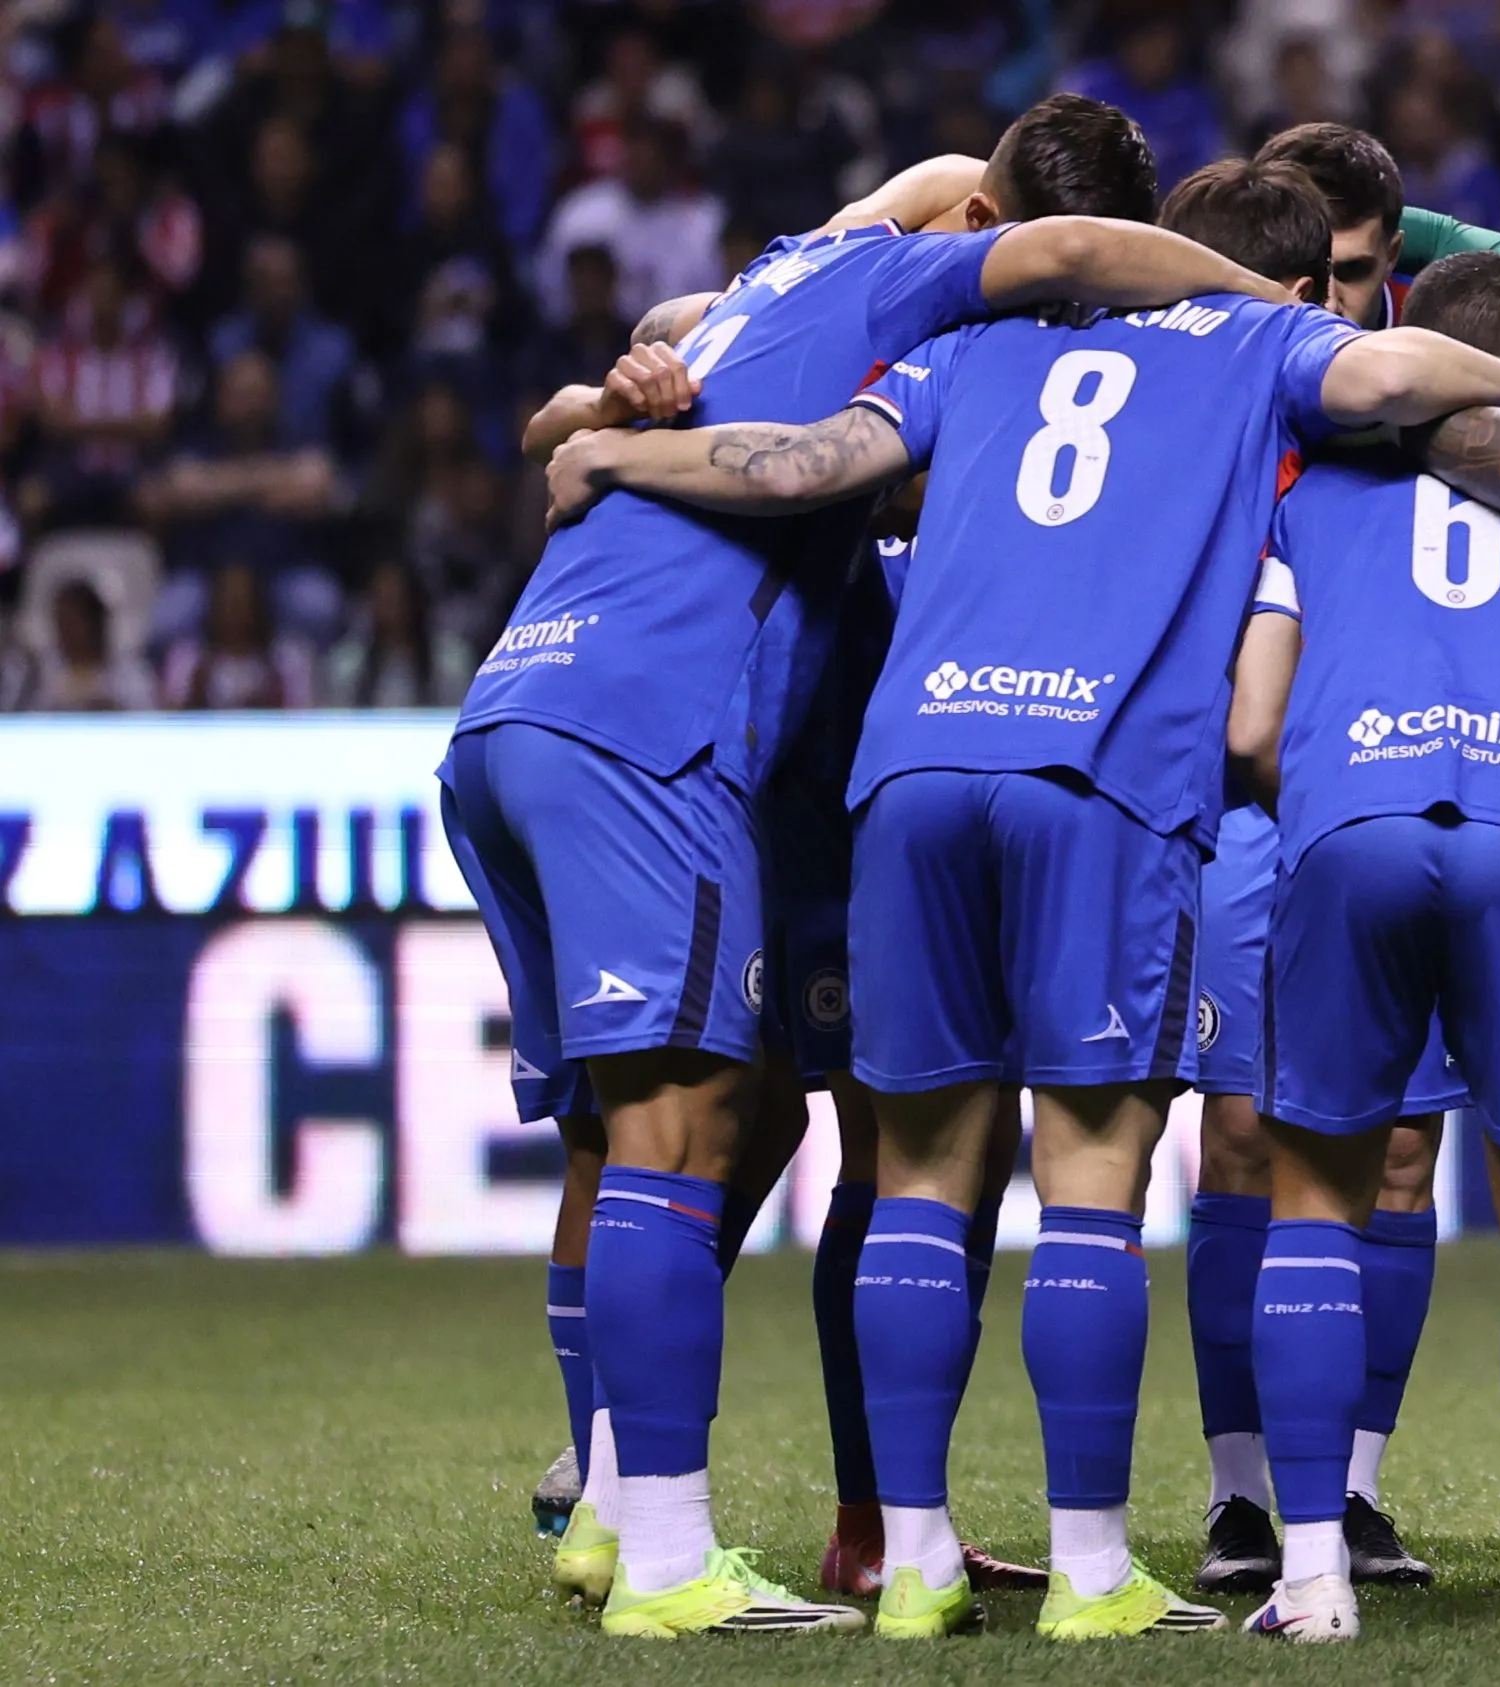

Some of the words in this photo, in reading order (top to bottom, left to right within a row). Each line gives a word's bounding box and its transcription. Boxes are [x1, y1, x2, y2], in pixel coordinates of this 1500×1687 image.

[1016, 349, 1137, 526] 8
[504, 612, 585, 652] cemix
[969, 665, 1100, 704] cemix
[917, 700, 1009, 716] ADHESIVOS
[1013, 704, 1025, 716] Y
[1027, 703, 1100, 723] ESTUCOS
[1349, 736, 1444, 766] ADHESIVOS
[1449, 737, 1460, 750] Y
[1263, 1303, 1314, 1314] CRUZ
